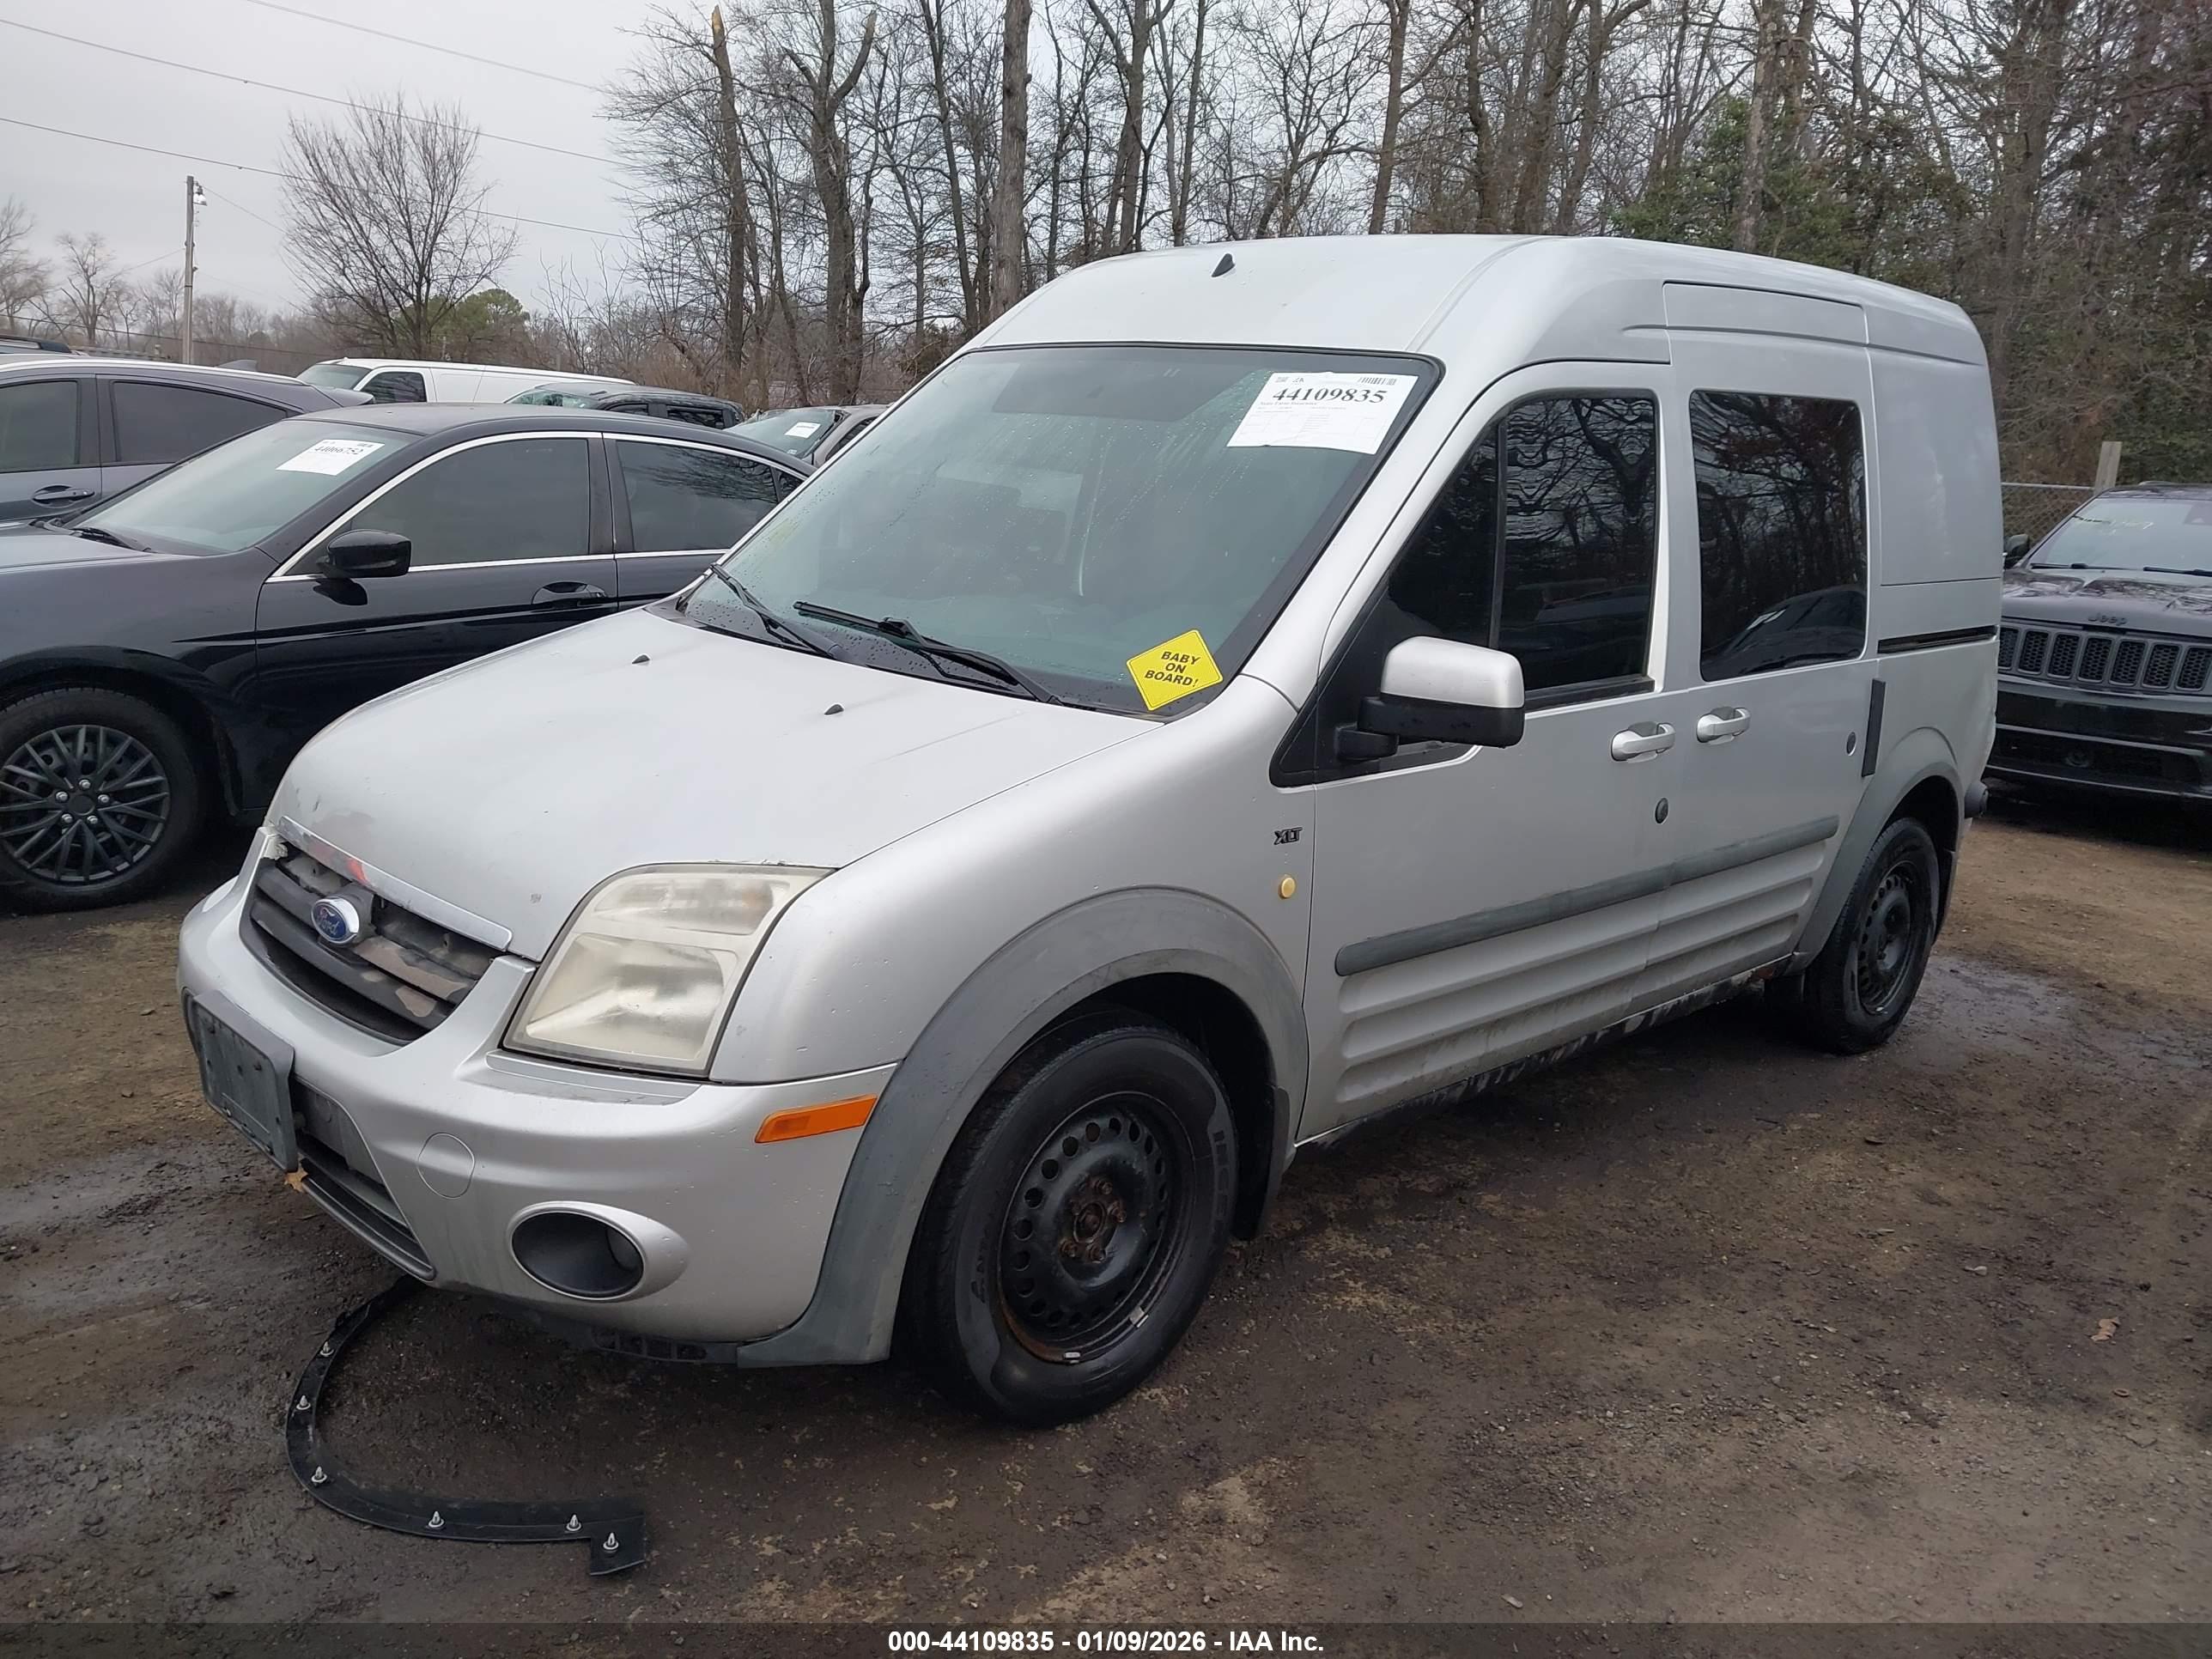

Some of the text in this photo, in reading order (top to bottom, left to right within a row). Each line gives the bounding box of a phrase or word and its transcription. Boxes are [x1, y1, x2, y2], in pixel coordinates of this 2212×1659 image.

[1273, 387, 1389, 404] 44109835
[2087, 612, 2128, 626] Jeep
[1161, 651, 1200, 665] BABY
[1165, 663, 1187, 674] ON
[1144, 670, 1199, 687] BOARD!
[1273, 827, 1303, 845] XLT
[317, 907, 341, 936] Ford
